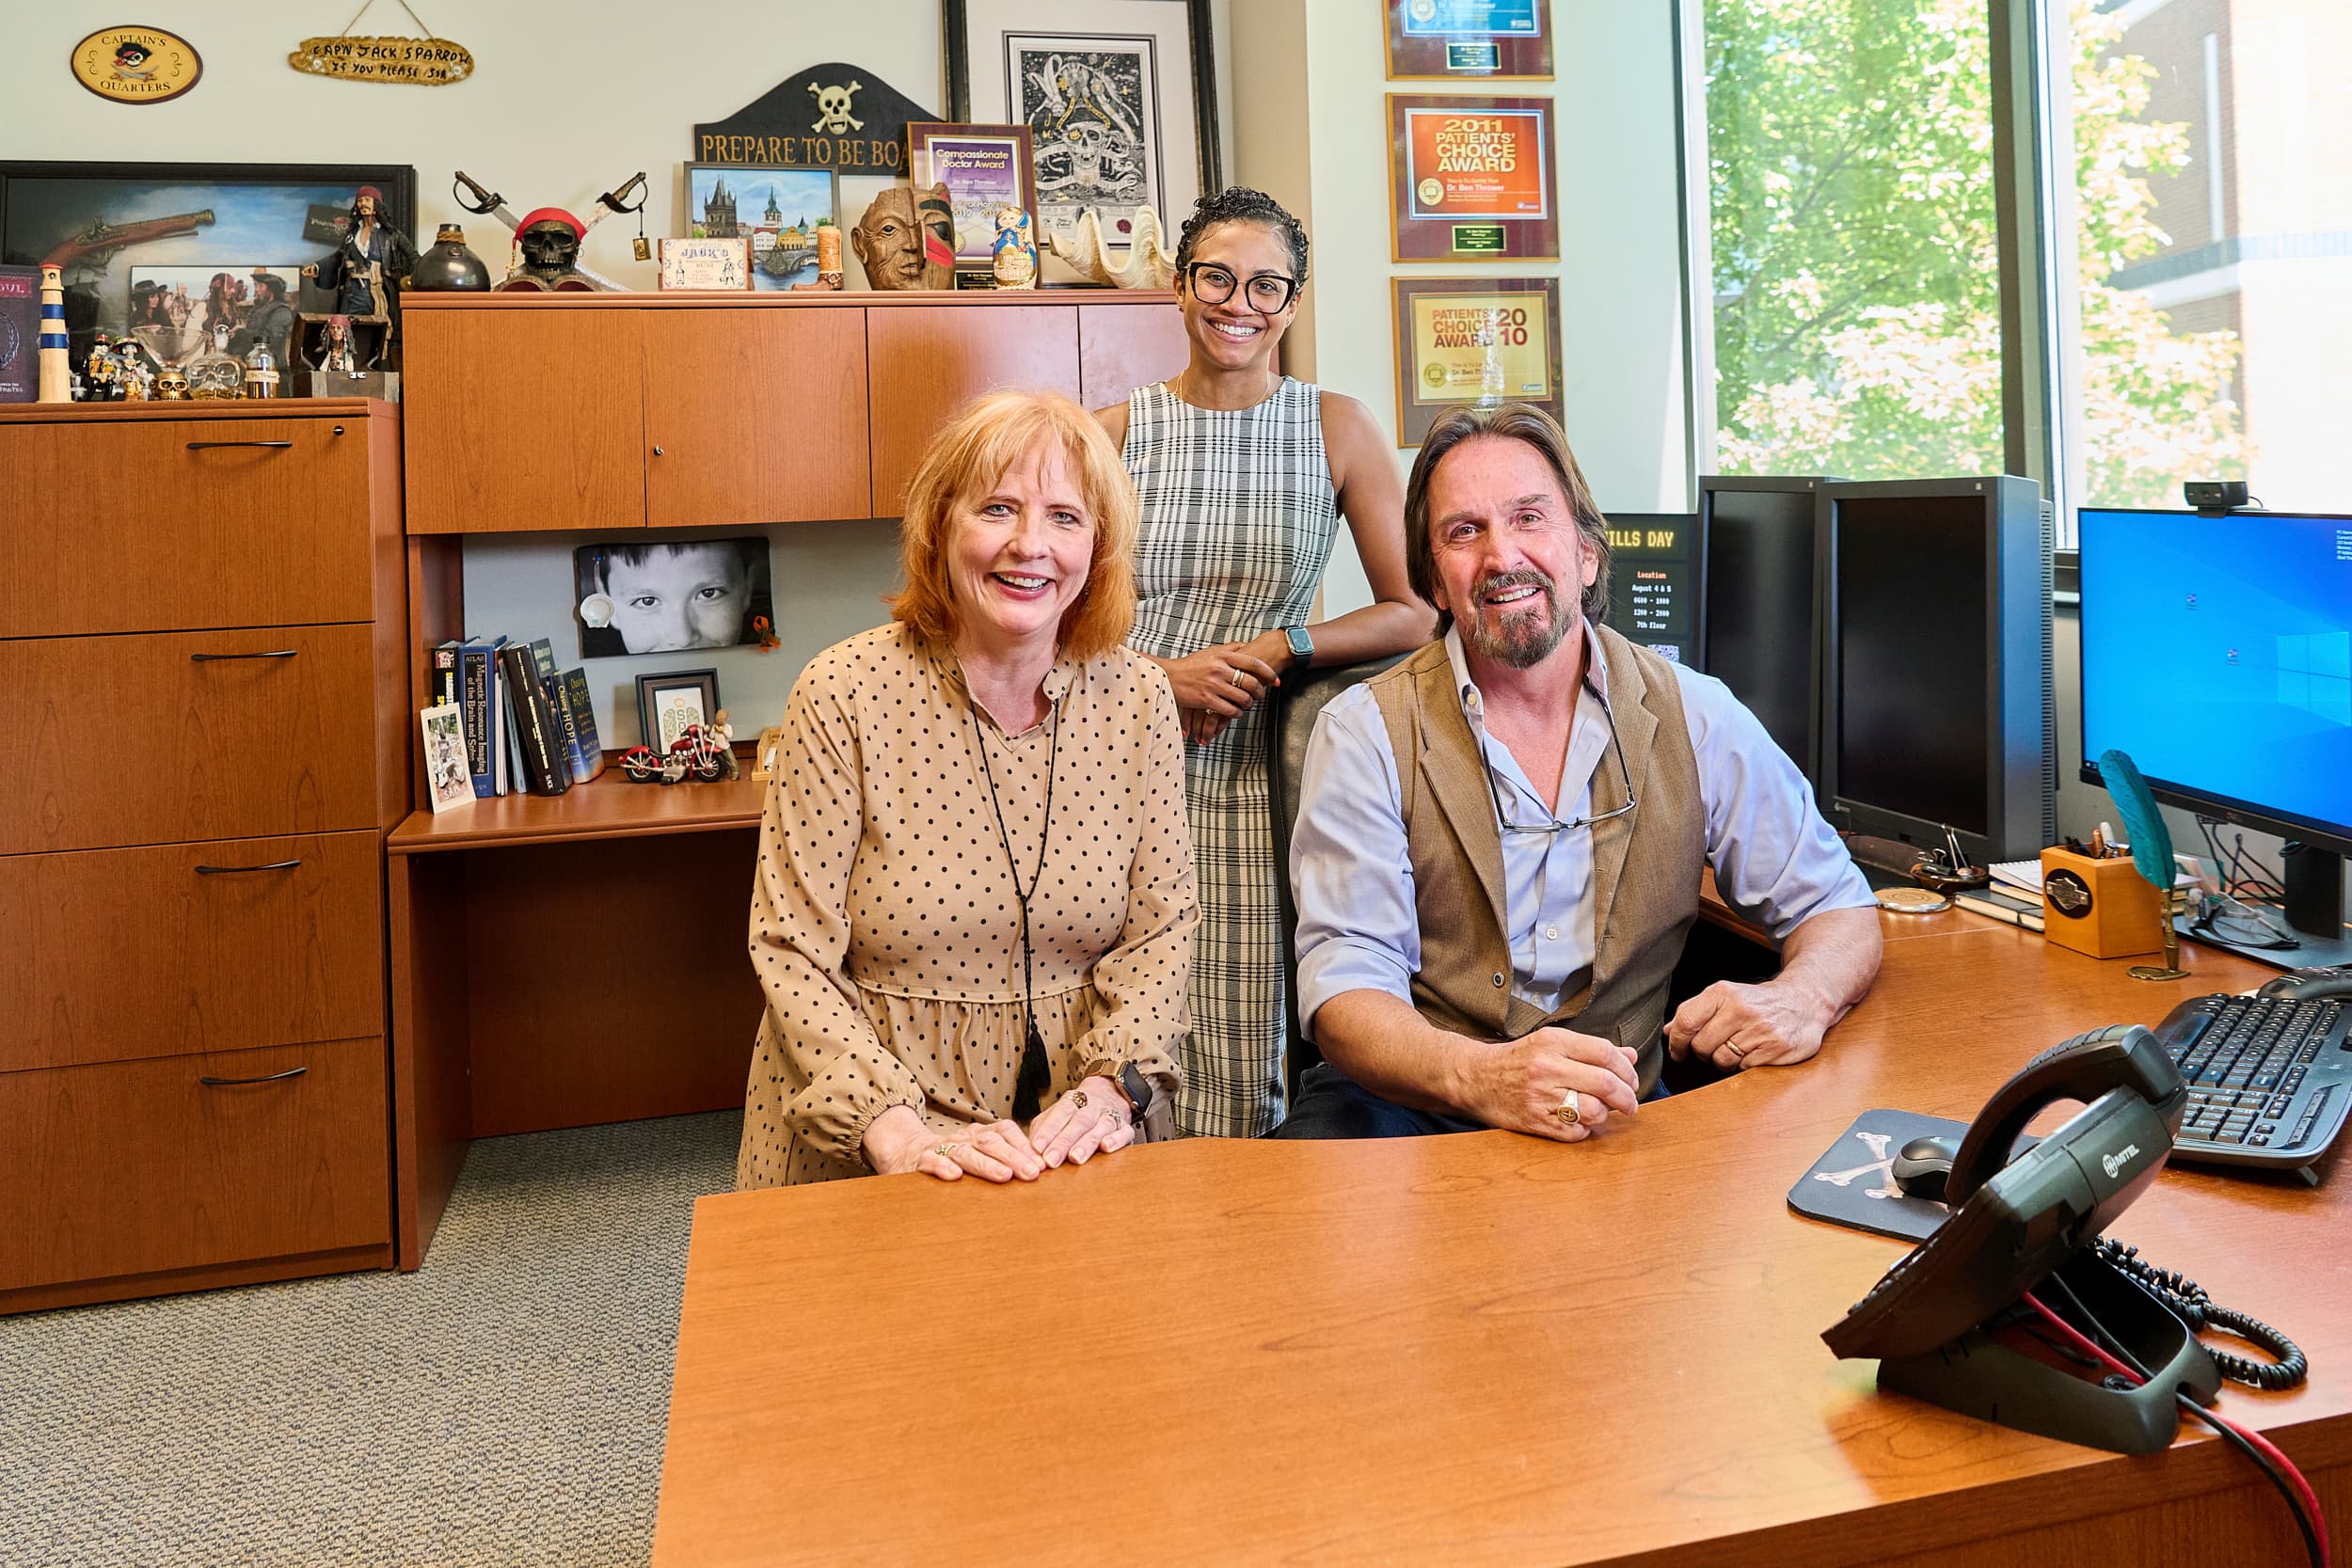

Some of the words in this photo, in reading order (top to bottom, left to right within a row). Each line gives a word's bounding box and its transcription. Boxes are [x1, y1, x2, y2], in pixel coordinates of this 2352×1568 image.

[101, 34, 167, 46] CAPTAIN'S
[357, 46, 397, 58] JACK
[404, 47, 470, 64] SPARROW
[353, 63, 373, 74] YOU
[380, 66, 419, 77] PLEASE
[427, 68, 447, 79] SIR
[101, 81, 171, 92] QUARTERS
[1444, 119, 1503, 133] 2011
[1436, 133, 1516, 144] PATIENTS'
[701, 135, 796, 164] PREPARE
[801, 136, 832, 165] TO
[838, 138, 865, 166] BE
[936, 150, 1009, 160] Compassionate
[1437, 143, 1517, 158] CHOICE
[942, 160, 972, 168] Doctor
[975, 160, 1005, 168] Award
[1438, 158, 1516, 172] AWARD
[1496, 308, 1527, 327] 20
[1500, 327, 1529, 347] 10
[1606, 531, 1641, 547] ILLS
[1647, 531, 1675, 547] DAY
[1637, 571, 1667, 579] Location
[1631, 584, 1652, 593] August
[465, 655, 485, 663] ATLAS
[468, 676, 476, 686] of
[476, 664, 485, 700] Magnetic
[468, 687, 476, 700] the
[572, 689, 590, 708] HOPE
[467, 700, 476, 722] Brain
[558, 685, 568, 712] Chasing
[563, 714, 577, 745] HOPE
[477, 701, 486, 741] Resonance
[469, 722, 477, 738] and
[477, 741, 487, 773] Imaging
[2114, 1143, 2140, 1167] MITEL
